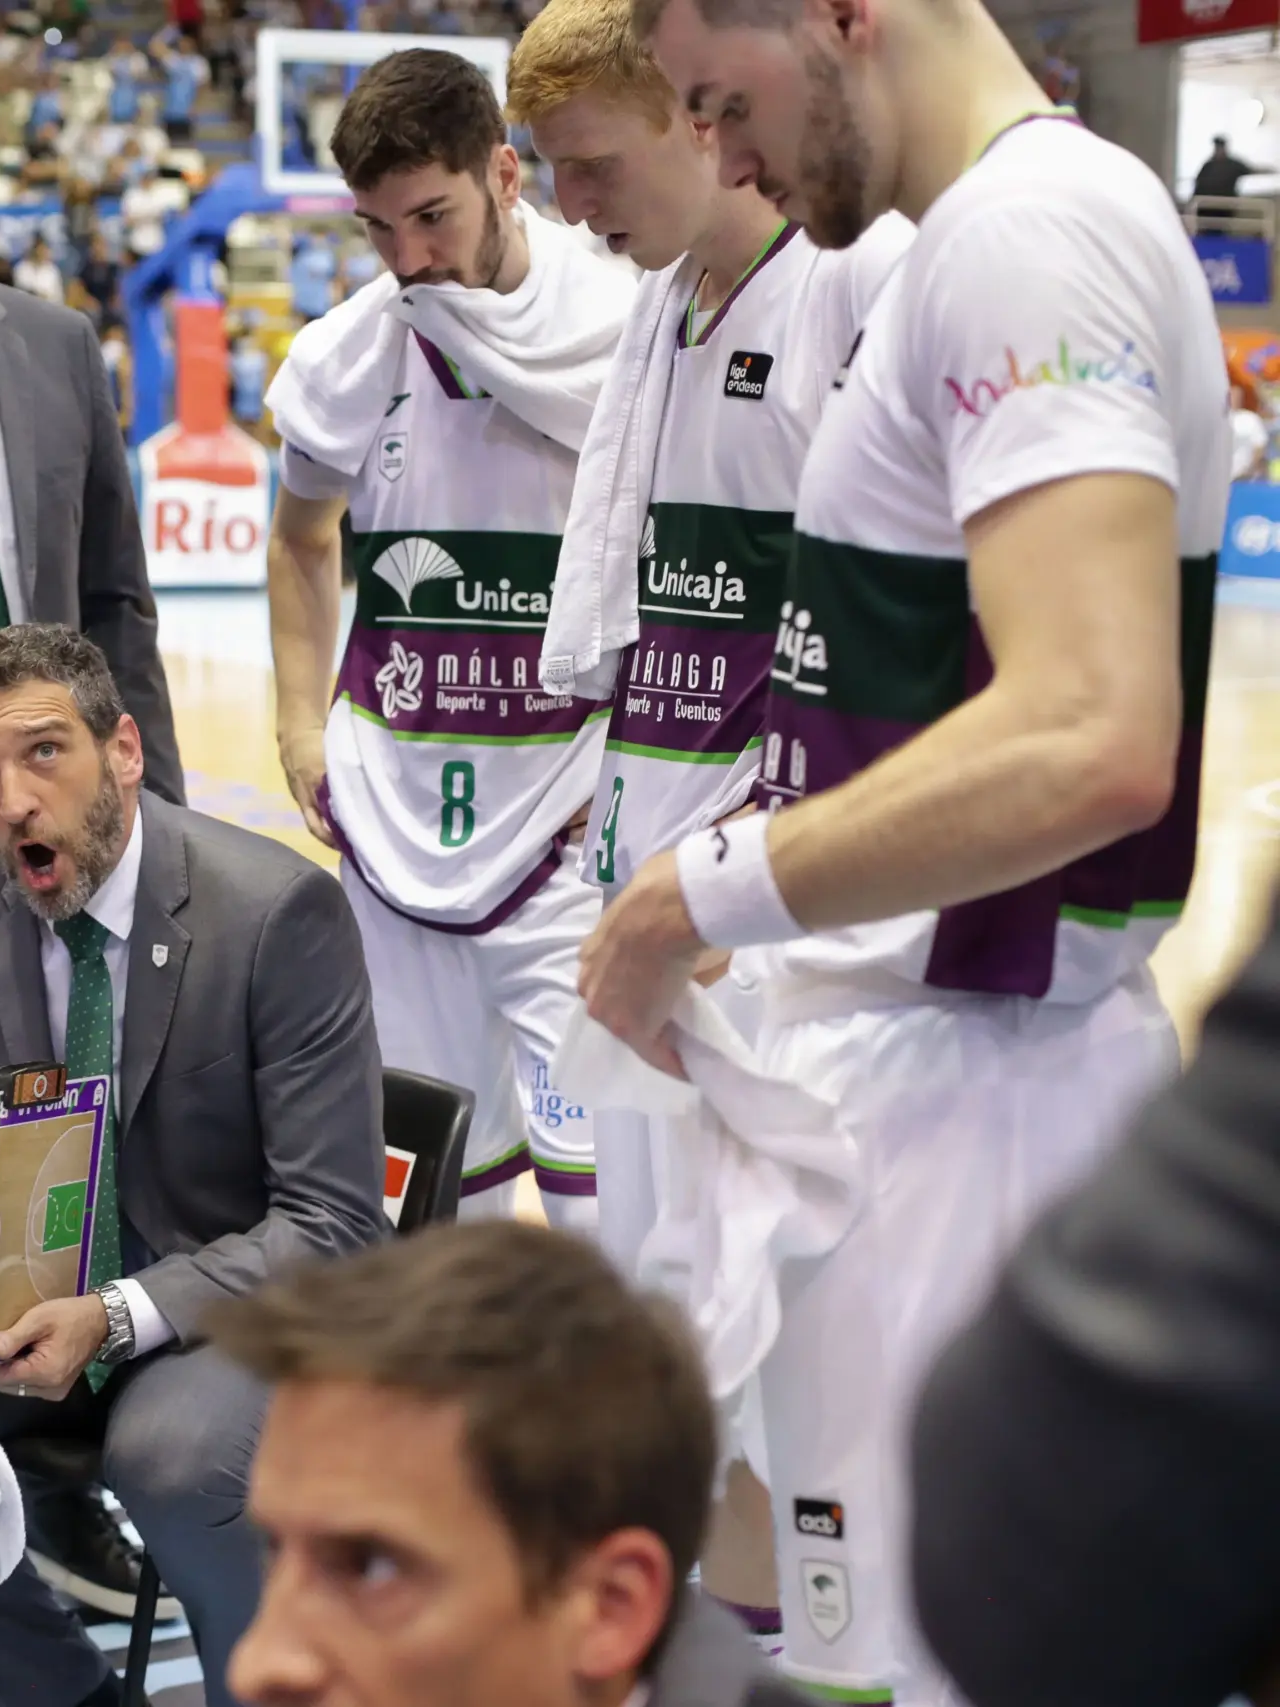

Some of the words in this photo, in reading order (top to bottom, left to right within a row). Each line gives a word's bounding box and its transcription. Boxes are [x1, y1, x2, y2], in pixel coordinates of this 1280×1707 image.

[727, 379, 762, 394] endesa
[730, 363, 747, 380] liga
[456, 578, 554, 614] Unica
[648, 557, 746, 610] Unicaja
[437, 647, 543, 688] MÁLA
[436, 691, 486, 714] Deporte
[499, 699, 508, 717] y
[657, 701, 665, 722] y
[675, 697, 722, 722] Eventos
[440, 760, 476, 847] 8
[596, 776, 624, 883] 9
[798, 1512, 838, 1535] acb
